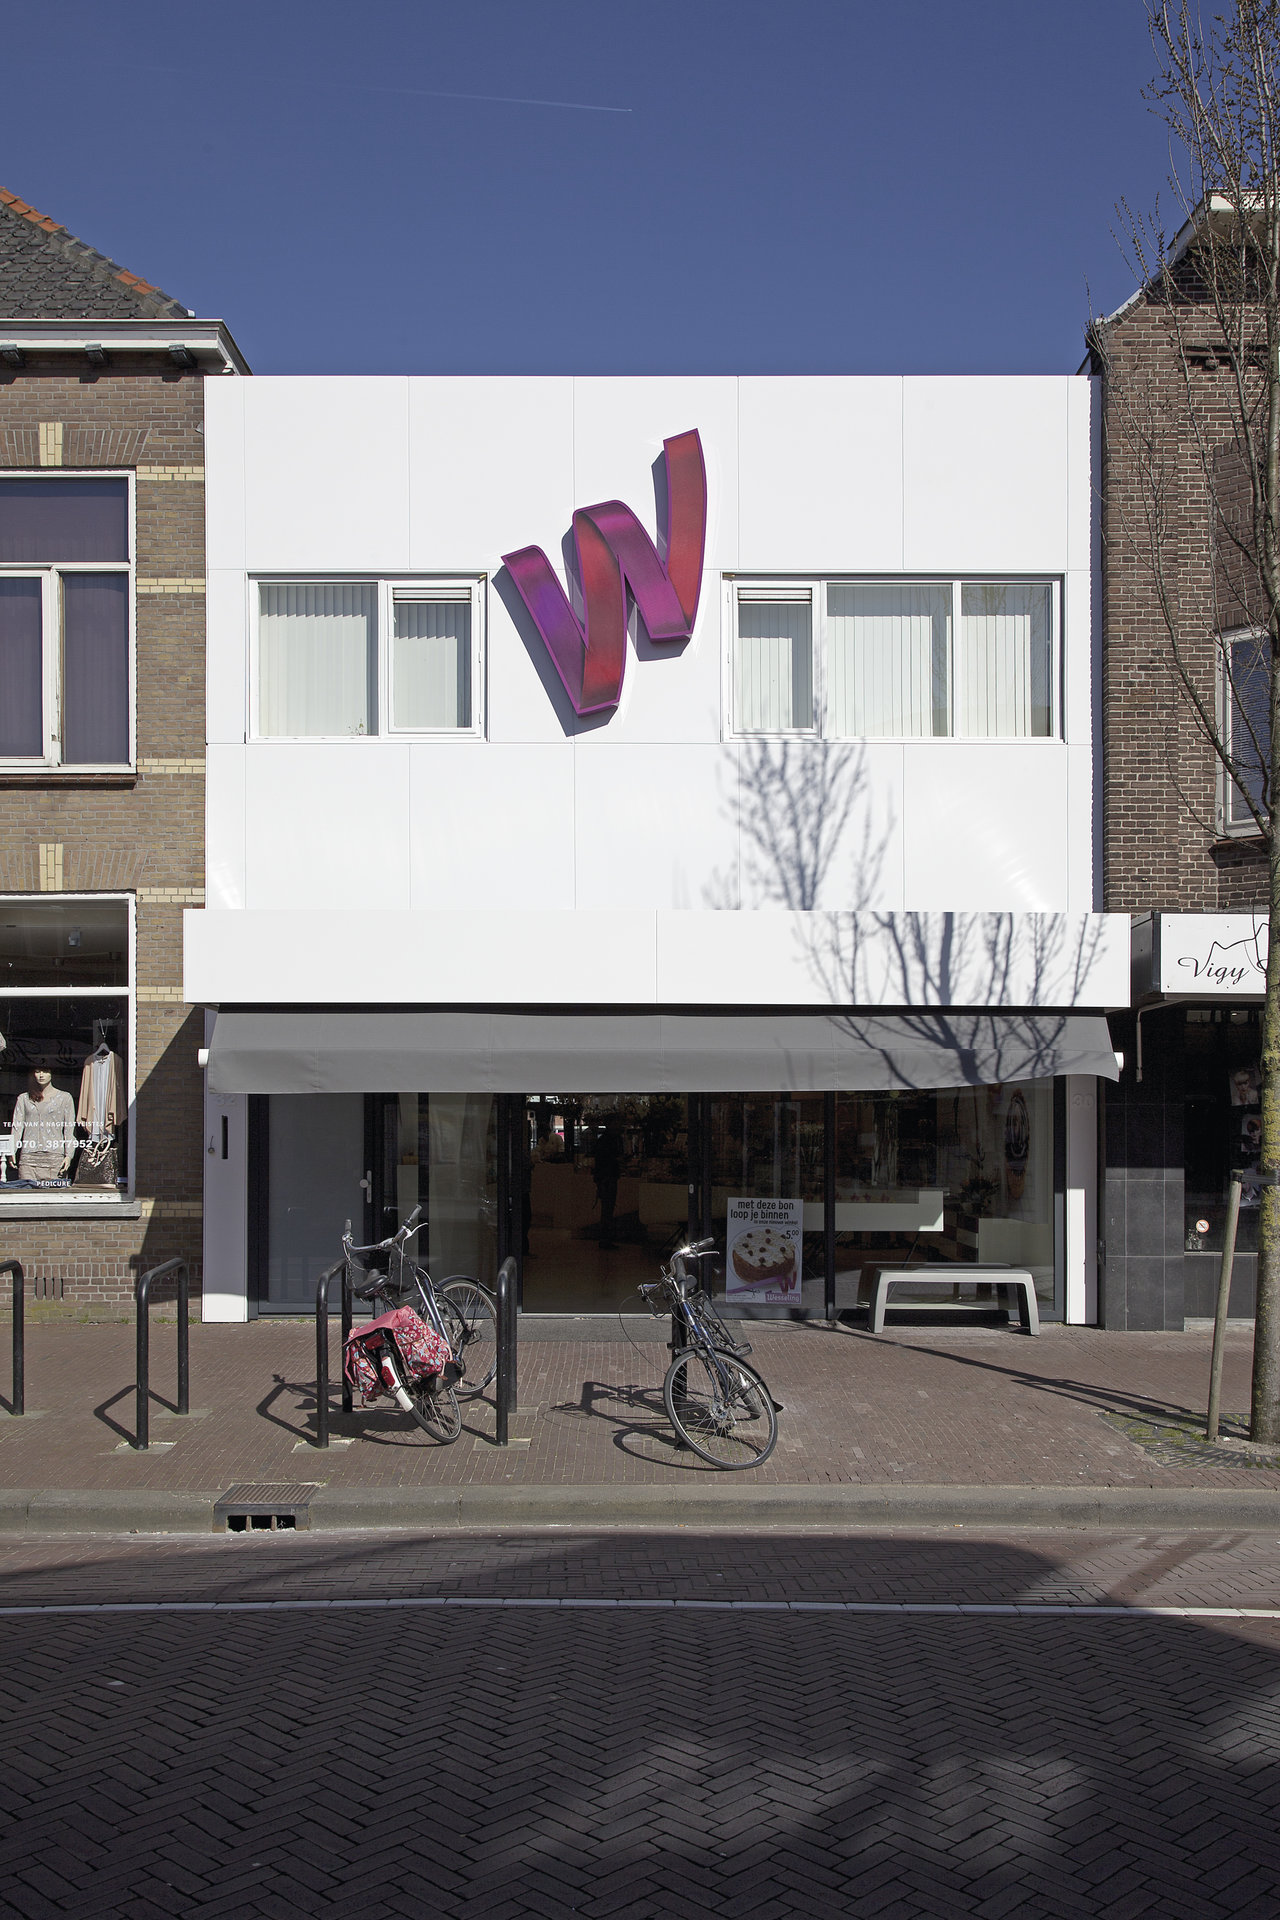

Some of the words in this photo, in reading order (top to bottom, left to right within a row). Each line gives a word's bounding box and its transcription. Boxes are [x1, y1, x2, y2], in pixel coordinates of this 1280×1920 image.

[1177, 956, 1250, 985] Vigy
[16, 1139, 35, 1149] 070
[46, 1139, 93, 1149] 3877952
[737, 1200, 754, 1210] met
[756, 1200, 776, 1210] deze
[778, 1200, 794, 1210] bon
[730, 1209, 748, 1220] loop
[750, 1210, 759, 1221] je
[760, 1210, 789, 1219] binnen
[766, 1293, 800, 1303] Wesseling
